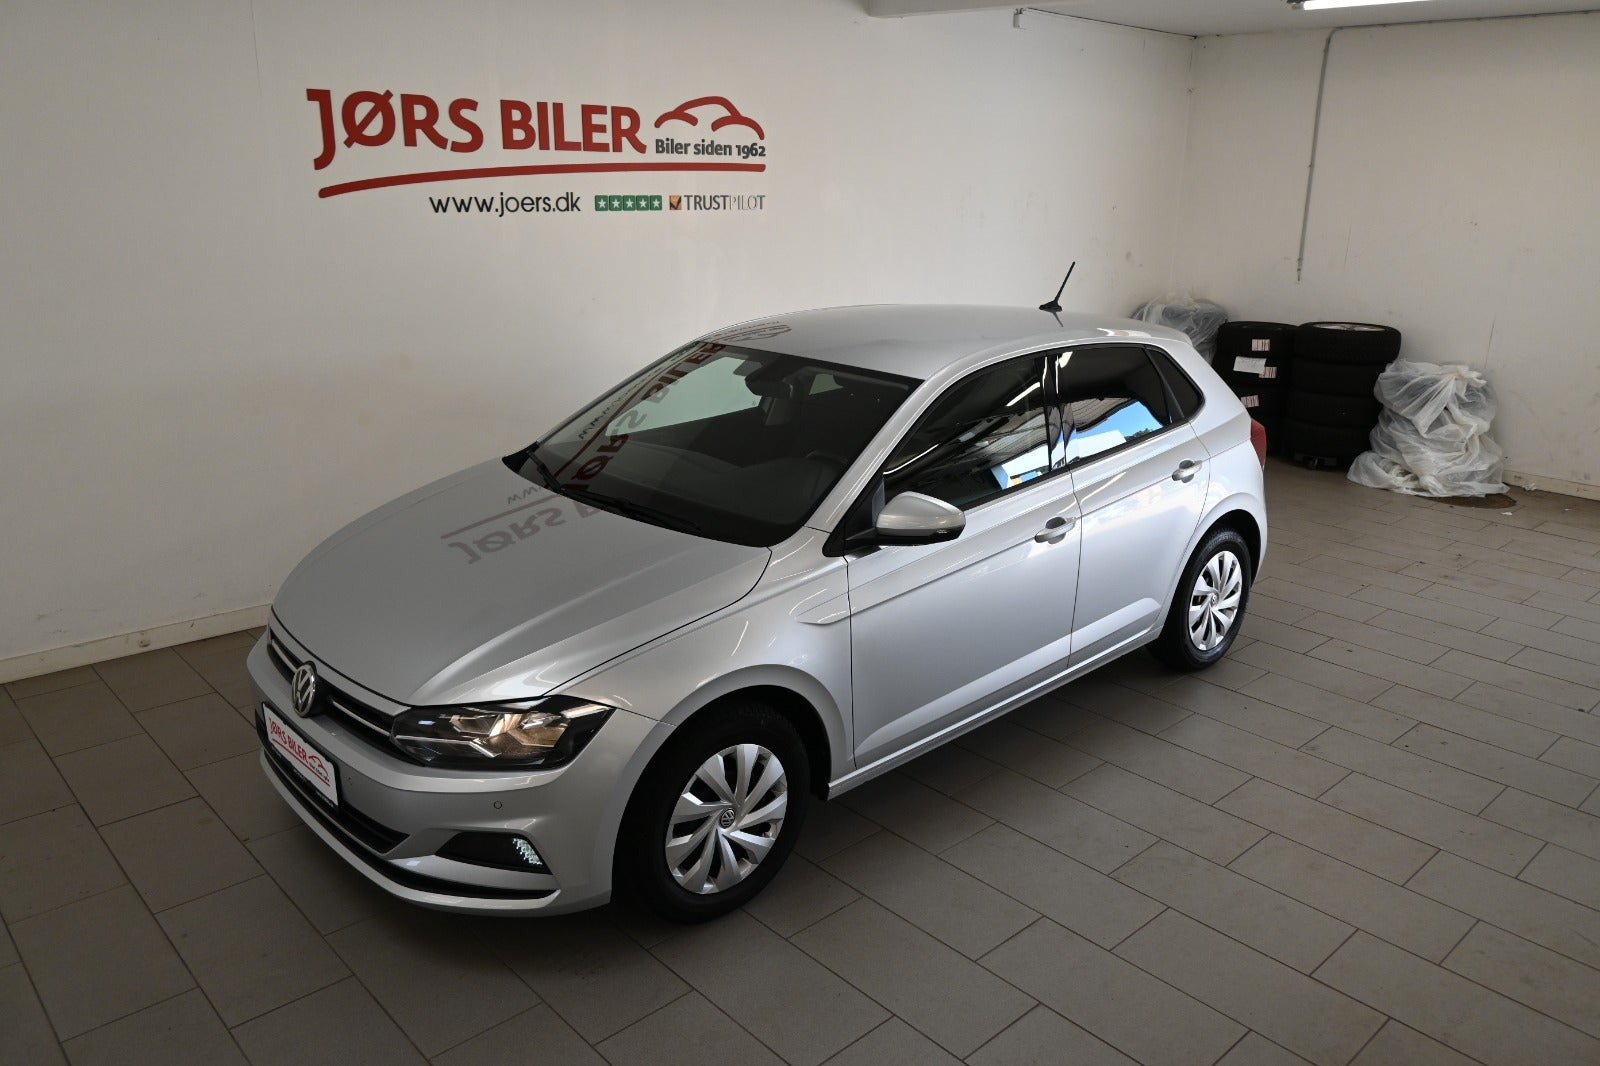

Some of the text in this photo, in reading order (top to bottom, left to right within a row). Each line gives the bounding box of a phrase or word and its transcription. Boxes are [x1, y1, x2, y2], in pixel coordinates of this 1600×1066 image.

[306, 88, 647, 171] JØRS BILER
[655, 138, 766, 159] Biler siden 1962
[429, 192, 581, 218] www.joers.dk
[684, 195, 766, 211] TRUSTPILOT
[287, 735, 309, 764] BILER
